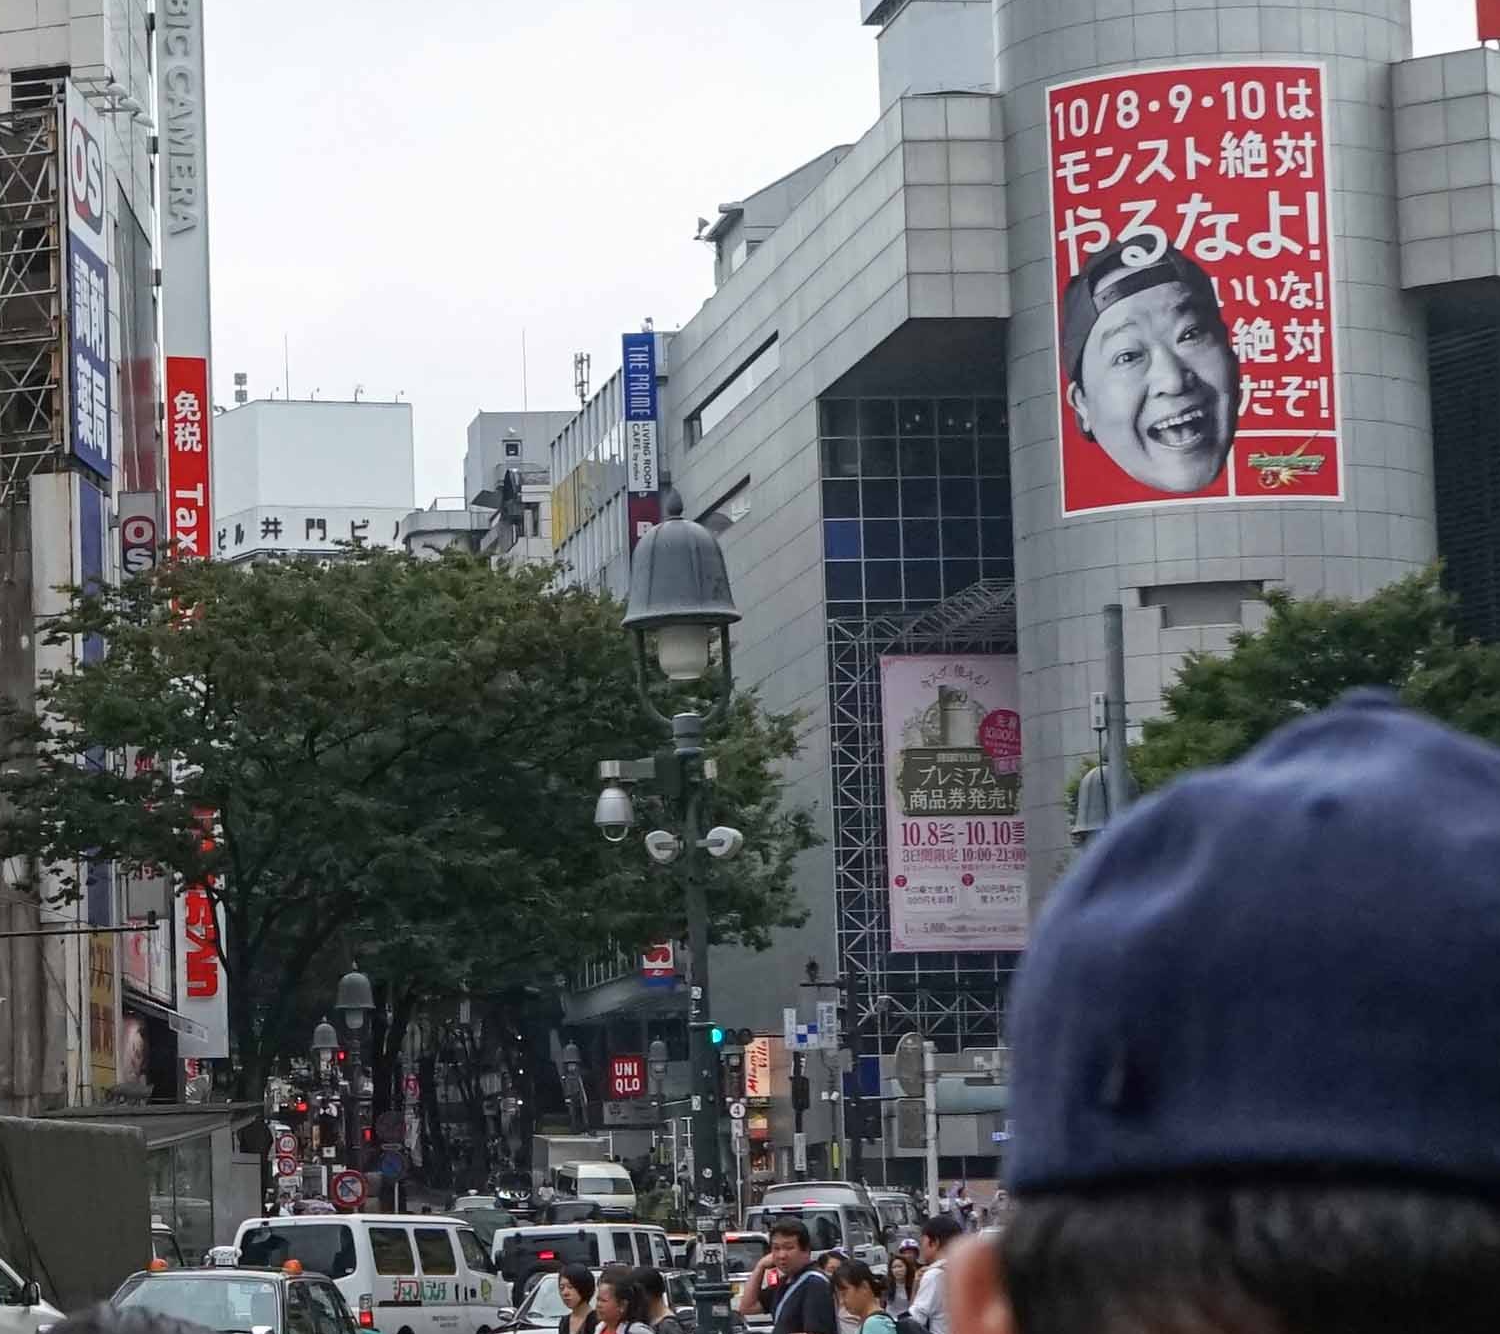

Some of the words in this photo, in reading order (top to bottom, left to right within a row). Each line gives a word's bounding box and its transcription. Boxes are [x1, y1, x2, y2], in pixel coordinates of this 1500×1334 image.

[166, 65, 199, 238] CAMERA
[1055, 132, 1317, 195] モンスト絶対
[1058, 189, 1322, 277] やるなよ!
[628, 344, 649, 370] THE
[1231, 317, 1326, 364] 絶対
[629, 374, 651, 416] PRIME
[1238, 374, 1330, 418] だぞ!
[172, 390, 203, 453] 免税
[173, 482, 204, 554] Tax
[920, 766, 997, 787] プレミアム
[909, 788, 1016, 811] 商品券発売!
[614, 1062, 639, 1077] UNI
[614, 1077, 641, 1093] QLO
